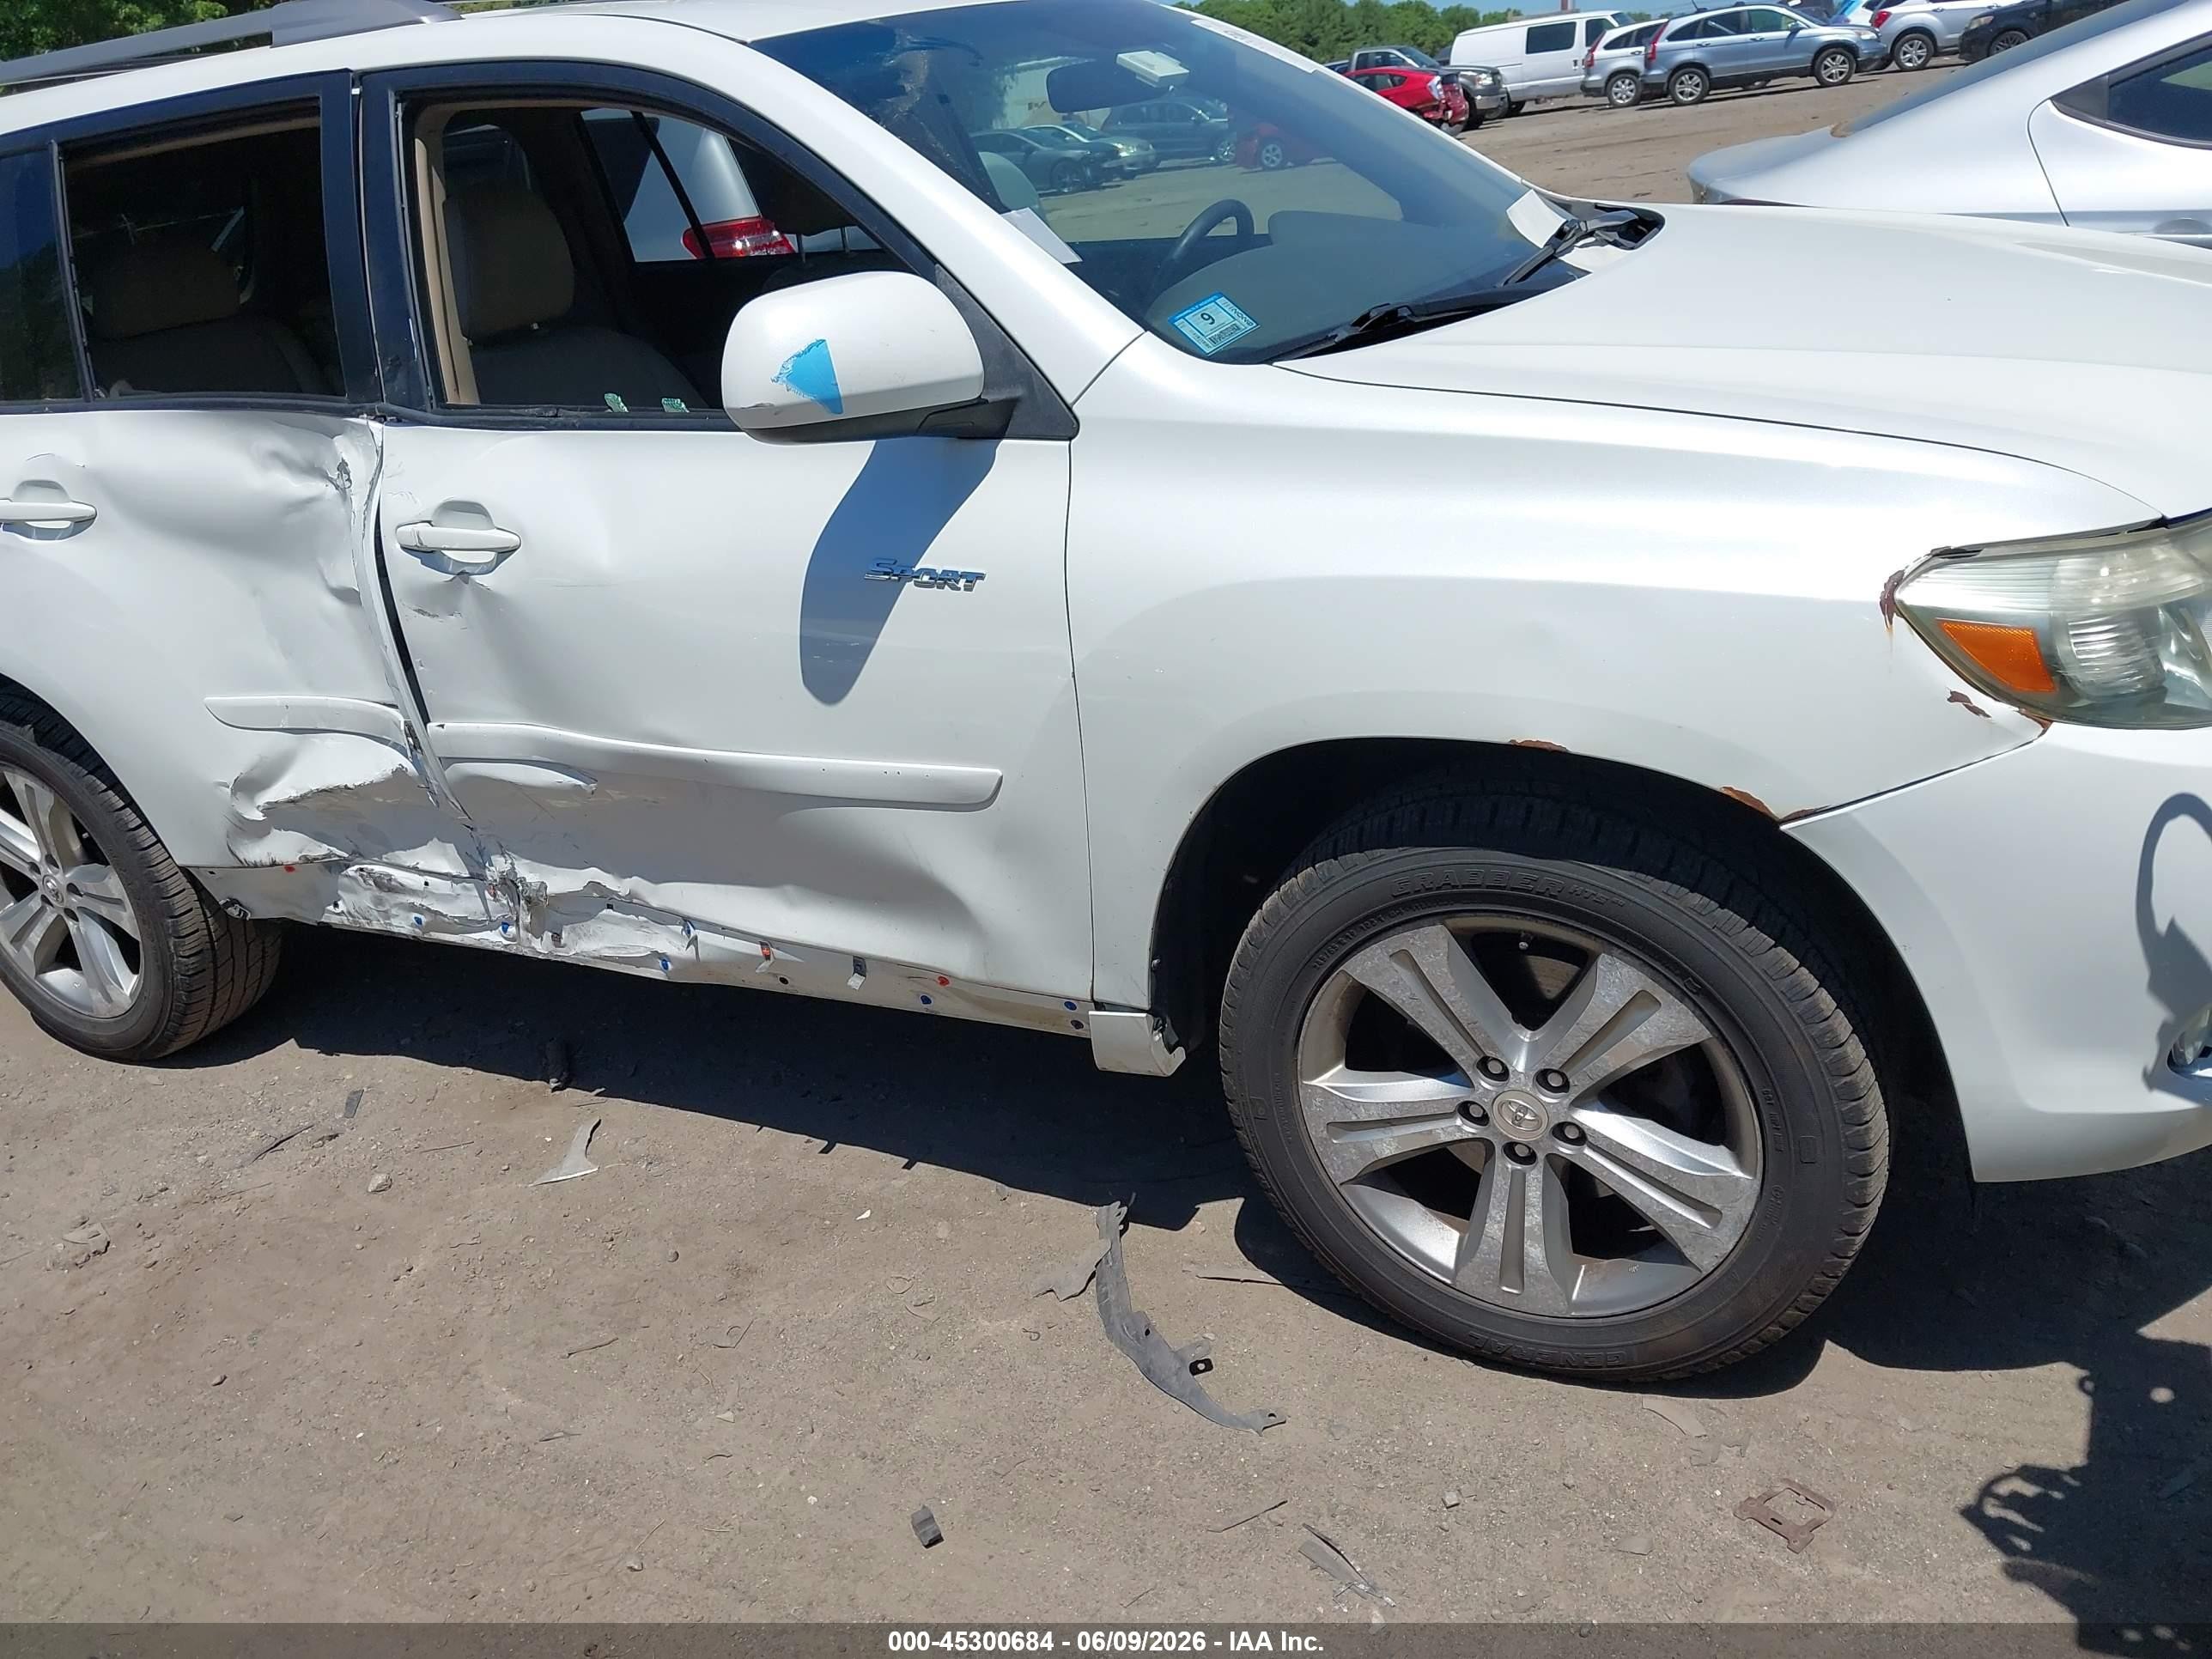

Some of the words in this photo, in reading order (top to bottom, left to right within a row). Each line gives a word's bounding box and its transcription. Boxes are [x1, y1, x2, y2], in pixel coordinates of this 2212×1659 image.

[1200, 312, 1216, 325] 9
[864, 557, 987, 592] SPORT
[1391, 868, 1566, 897] GRABBER
[1468, 1331, 1627, 1367] GENERAL
